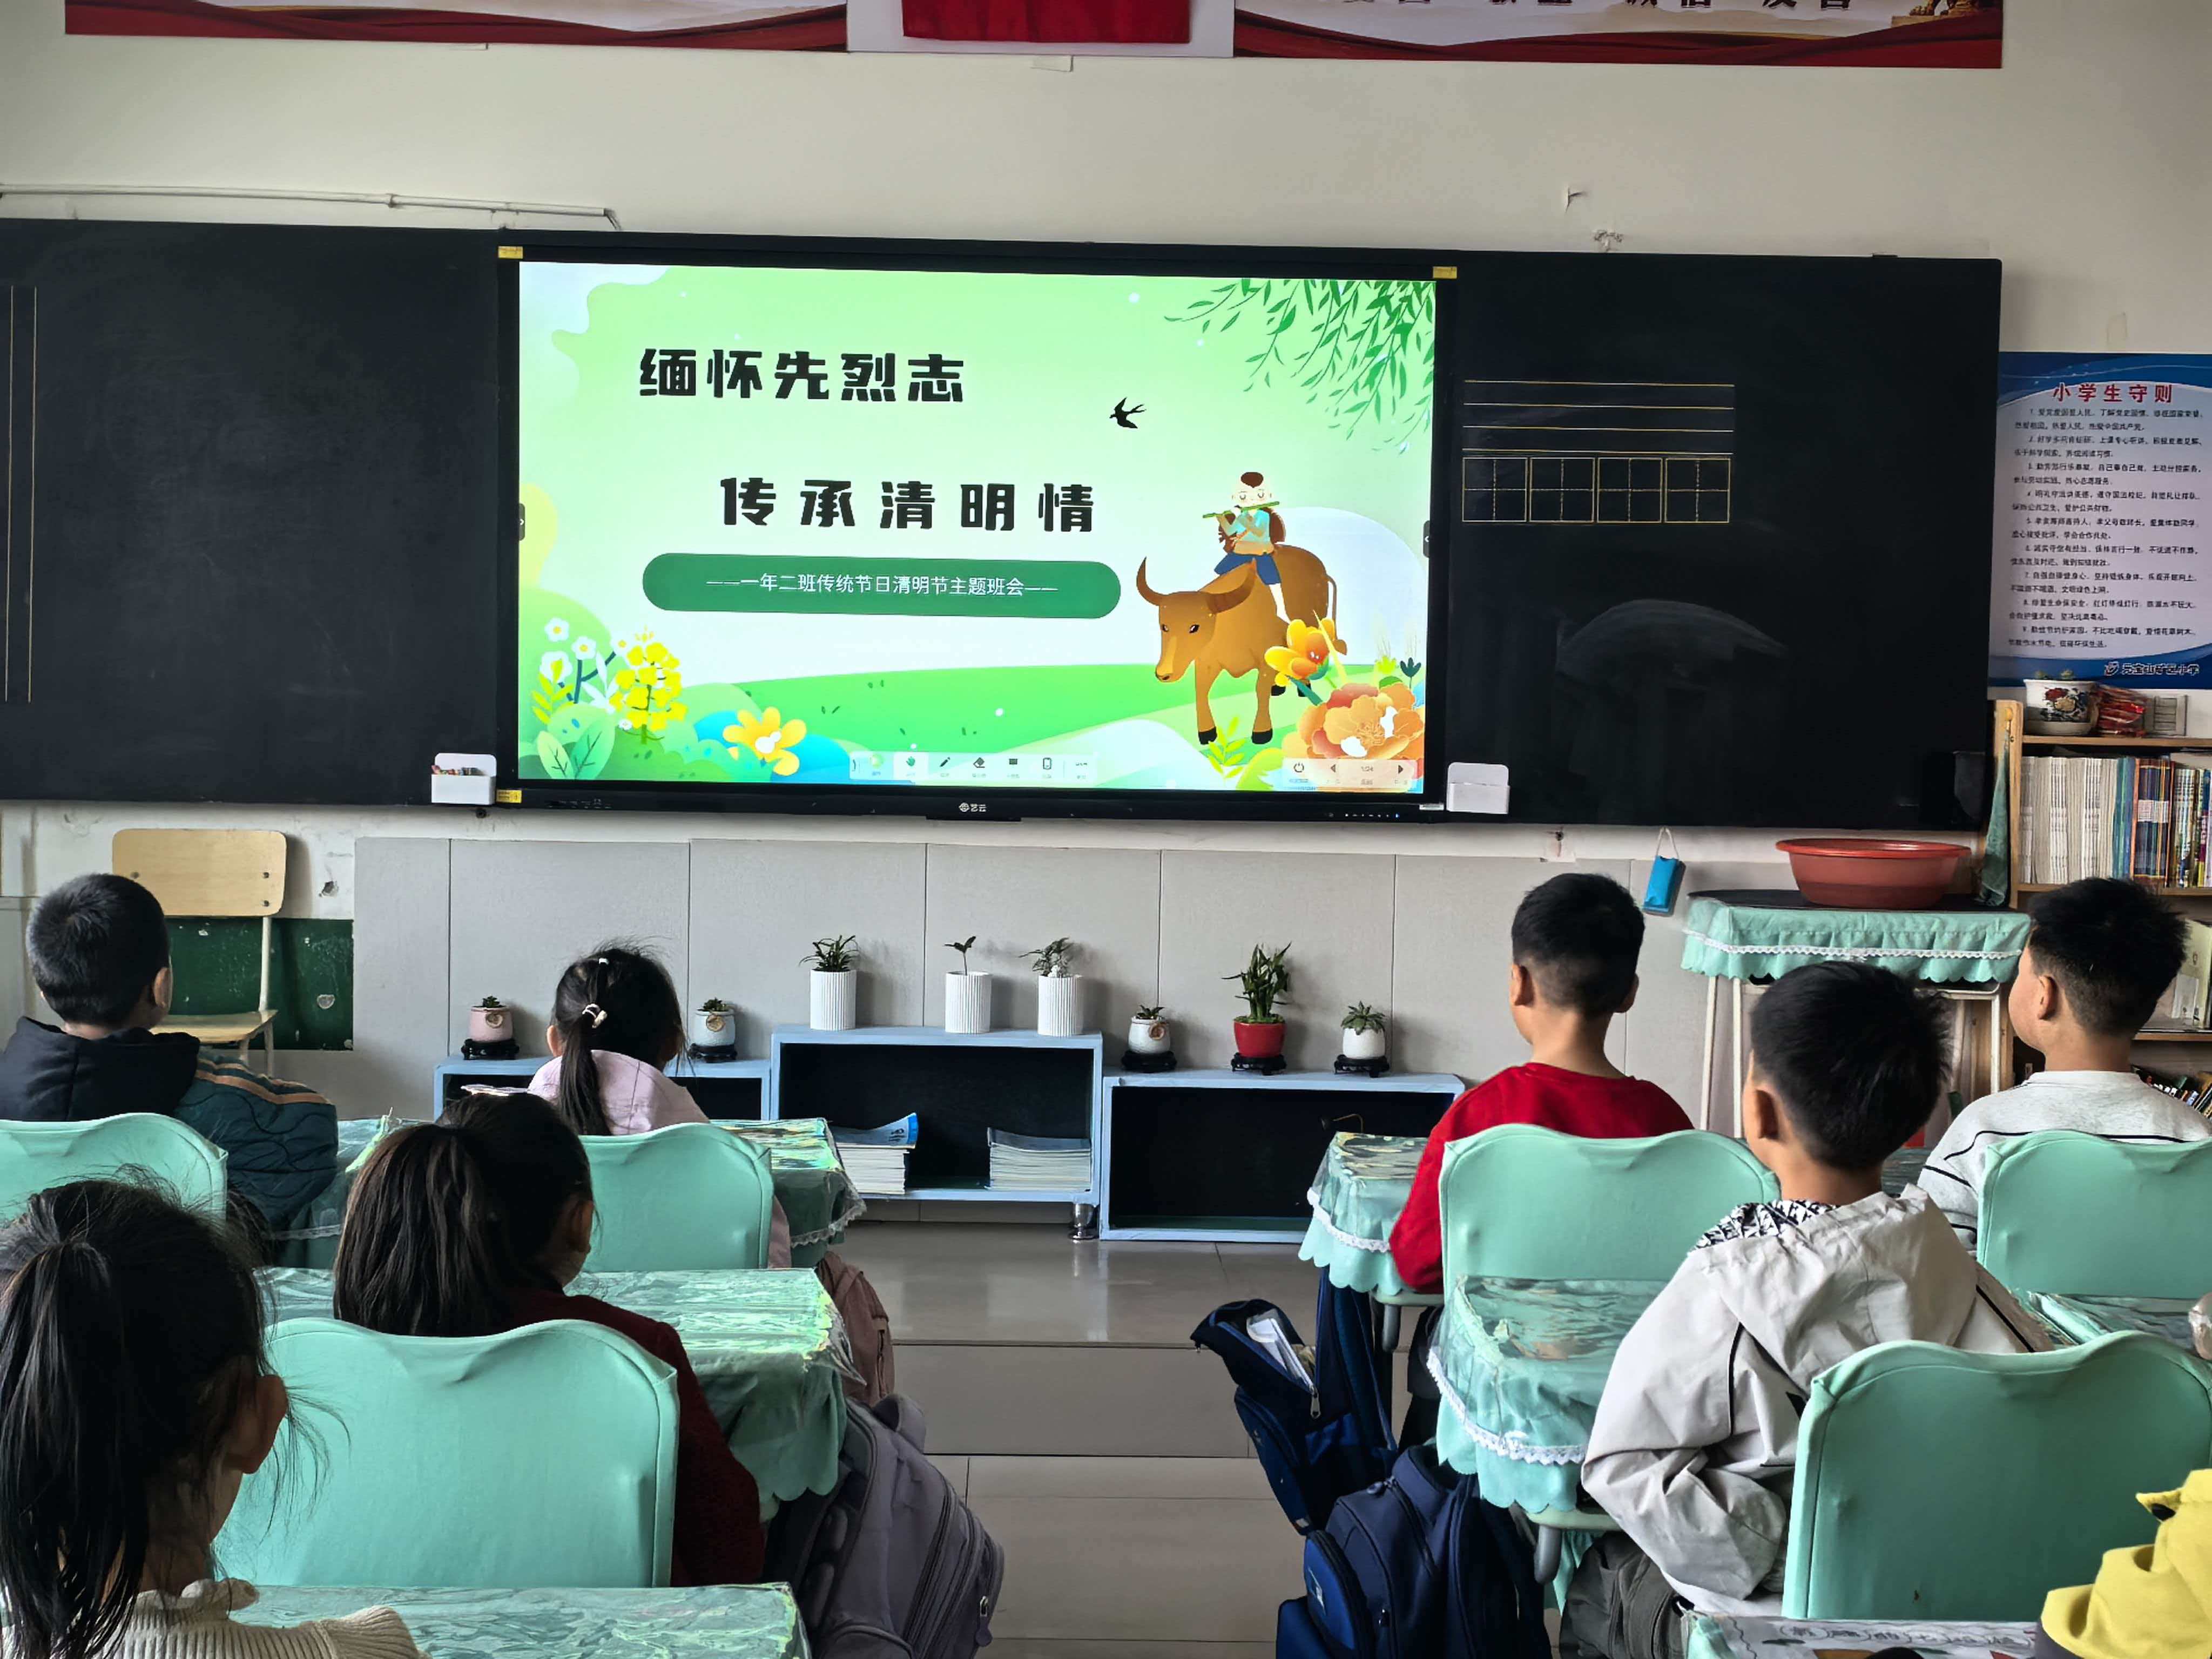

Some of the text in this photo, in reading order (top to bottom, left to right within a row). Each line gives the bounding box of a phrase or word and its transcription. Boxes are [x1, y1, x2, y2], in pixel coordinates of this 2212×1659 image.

[639, 348, 965, 402] 缅怀先烈志
[2053, 383, 2173, 403] 小学生守则
[720, 477, 1094, 532] 传承清明情
